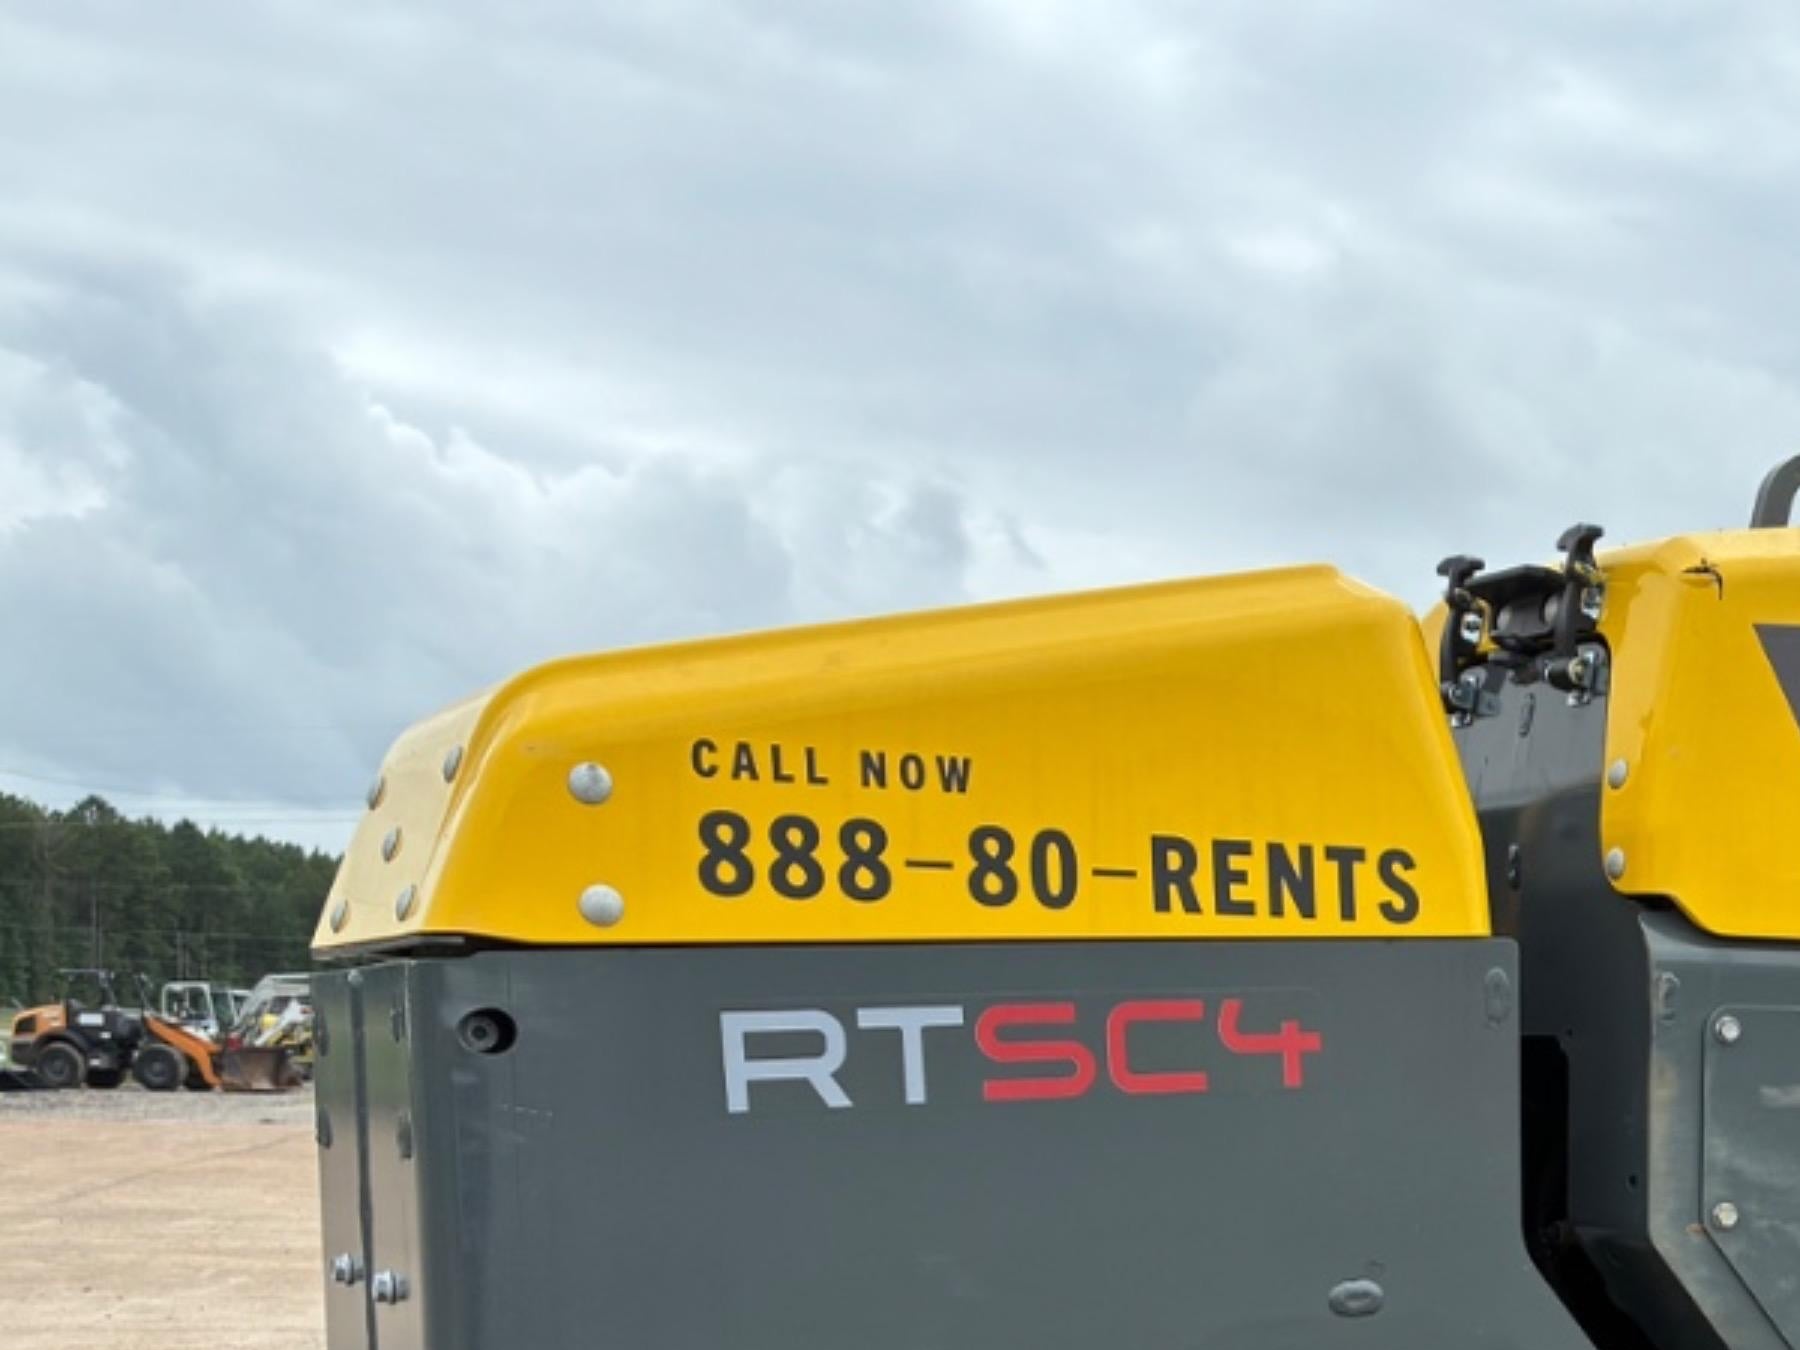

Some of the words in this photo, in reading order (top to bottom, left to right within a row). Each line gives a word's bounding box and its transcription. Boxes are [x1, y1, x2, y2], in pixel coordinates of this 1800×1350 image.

[690, 737, 829, 785] CALL
[859, 749, 973, 794] NOW
[697, 809, 1420, 925] 888-80-RENTS
[719, 998, 1322, 1114] RTSC4
